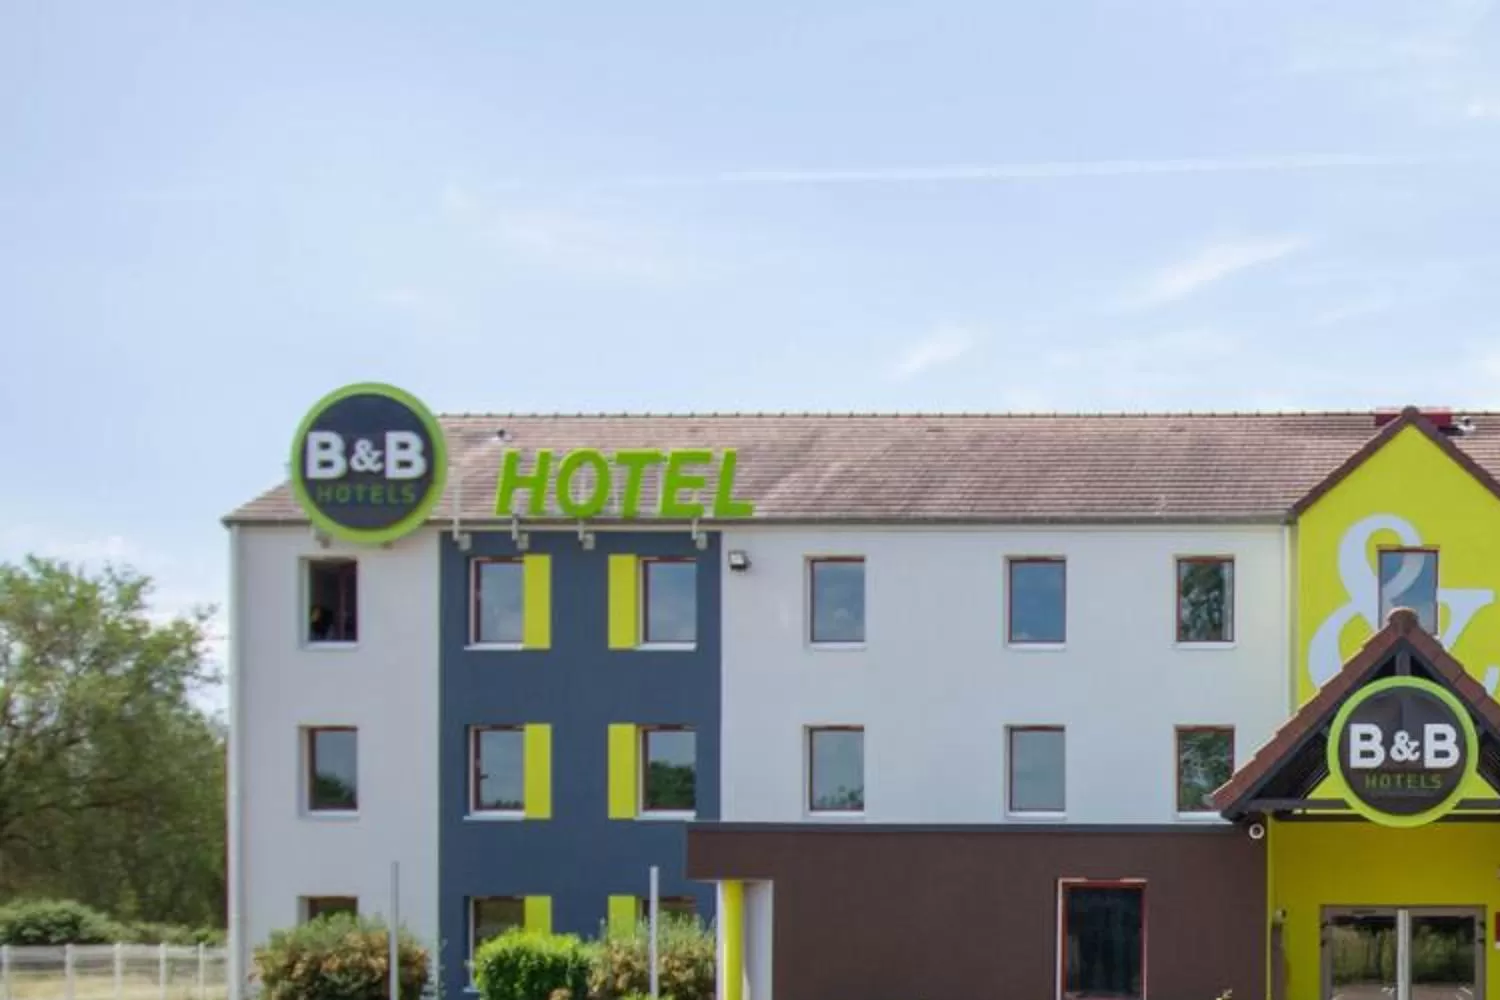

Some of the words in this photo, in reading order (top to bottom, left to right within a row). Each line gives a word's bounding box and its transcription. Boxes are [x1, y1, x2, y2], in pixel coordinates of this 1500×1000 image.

[306, 431, 427, 479] B&B
[317, 484, 415, 504] HOTELS
[495, 448, 755, 519] HOTEL
[1350, 723, 1460, 768] B&B
[1365, 773, 1443, 789] HOTELS
